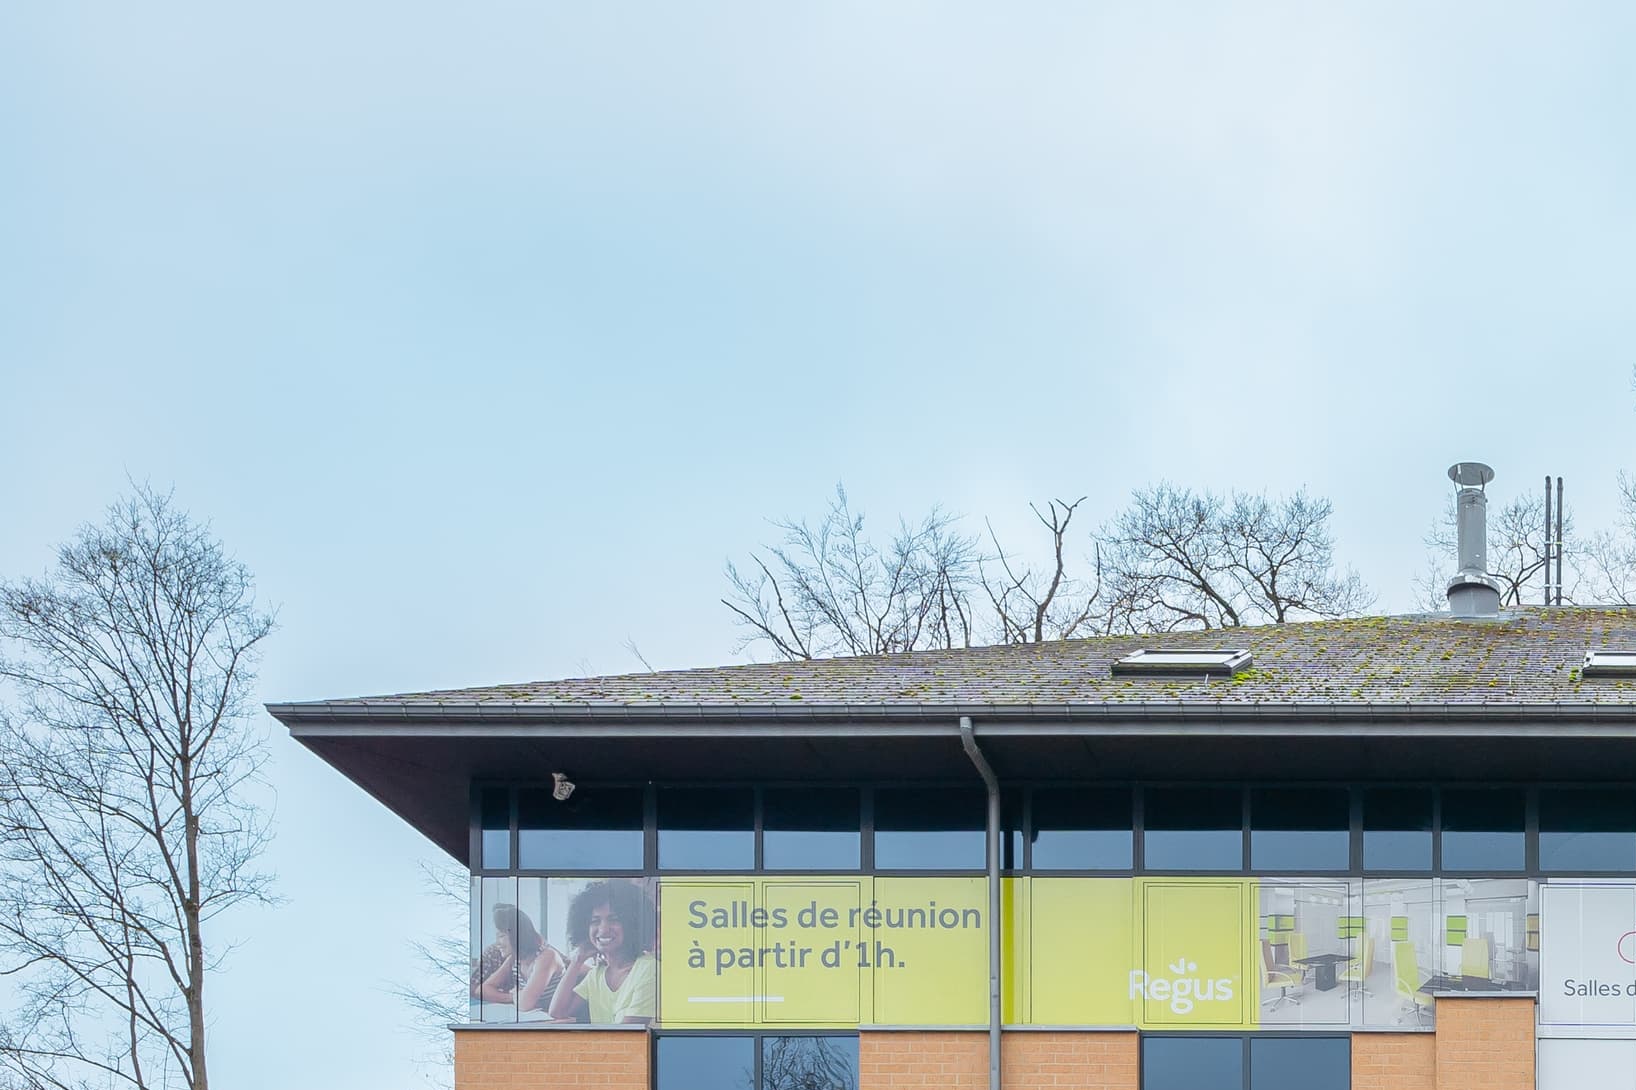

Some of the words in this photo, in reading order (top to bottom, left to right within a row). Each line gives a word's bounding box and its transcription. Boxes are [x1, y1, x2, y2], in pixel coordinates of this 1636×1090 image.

[687, 901, 788, 929] Salles
[798, 901, 839, 929] de
[848, 898, 982, 929] réunion
[687, 940, 706, 969] à
[716, 940, 814, 975] partir
[821, 940, 906, 969] d'1h.
[1128, 958, 1233, 1014] Regus
[1564, 979, 1621, 997] Salles
